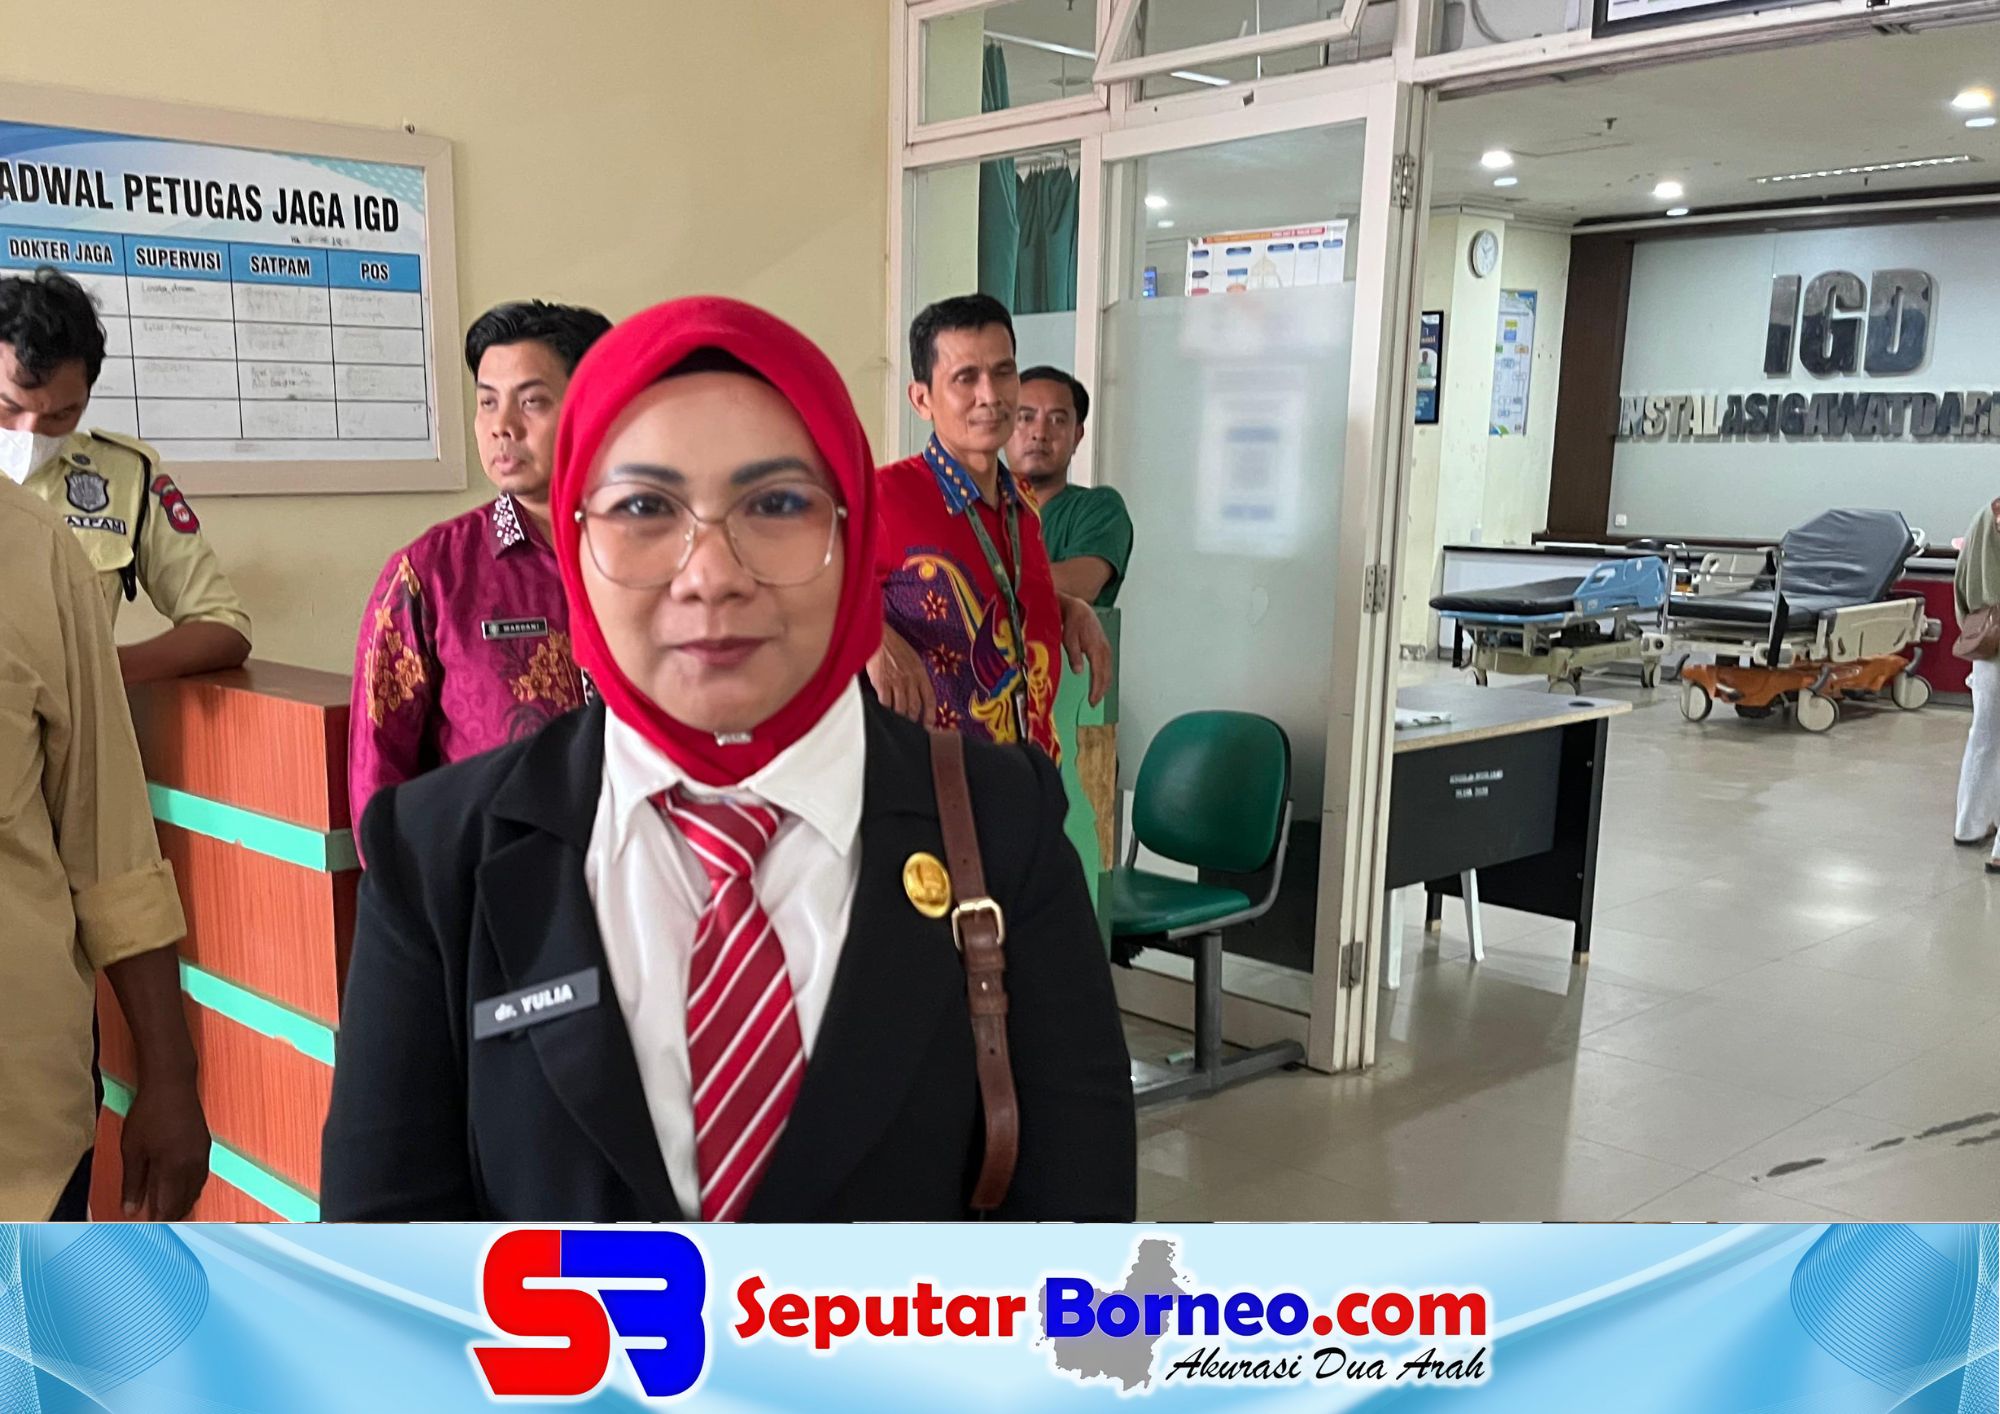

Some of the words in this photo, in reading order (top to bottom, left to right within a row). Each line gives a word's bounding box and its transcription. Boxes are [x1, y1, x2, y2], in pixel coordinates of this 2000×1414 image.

[124, 173, 262, 223] PETUGAS
[273, 187, 345, 229] JAGA
[354, 194, 399, 233] IGD
[9, 238, 70, 260] DOKTER
[75, 242, 113, 264] JAGA
[136, 247, 222, 271] SUPERVISI
[250, 255, 311, 278] SATPAM
[360, 262, 389, 281] POS
[1764, 269, 1936, 377] IGD
[494, 1002, 518, 1022] dr.
[521, 983, 573, 1014] YULIA
